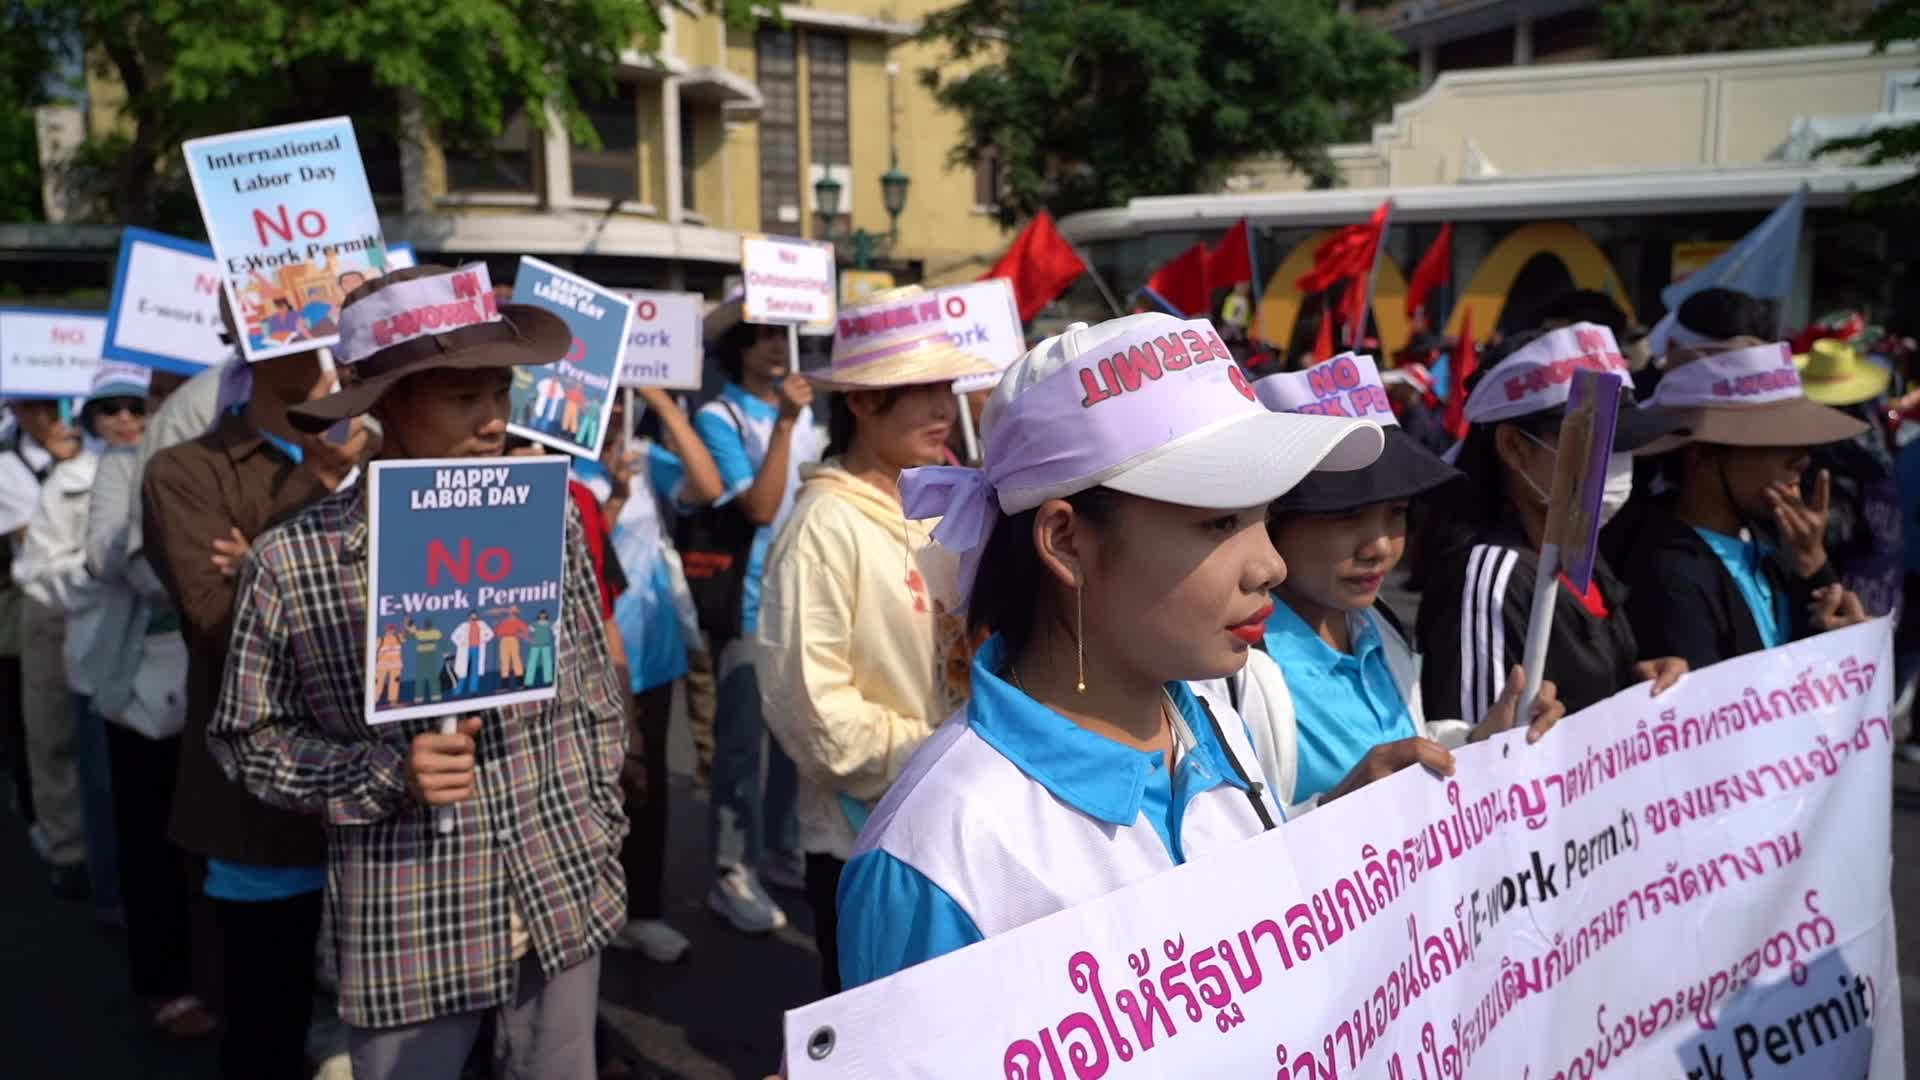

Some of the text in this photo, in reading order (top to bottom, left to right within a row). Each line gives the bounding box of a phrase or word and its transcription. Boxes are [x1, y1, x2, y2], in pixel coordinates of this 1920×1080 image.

[206, 134, 341, 170] International
[232, 165, 337, 194] Labor Day
[252, 203, 329, 247] No
[227, 231, 376, 275] E-Work Permit
[750, 271, 829, 295] Outsourcing
[766, 296, 816, 314] Service
[1079, 329, 1236, 408] PERMIT
[1306, 357, 1361, 400] NO
[435, 467, 510, 490] HAPPY
[410, 484, 531, 511] LABOR DAY
[426, 536, 513, 588] No
[379, 580, 558, 617] E-Work Permit
[1733, 973, 1875, 1080] Permit)
